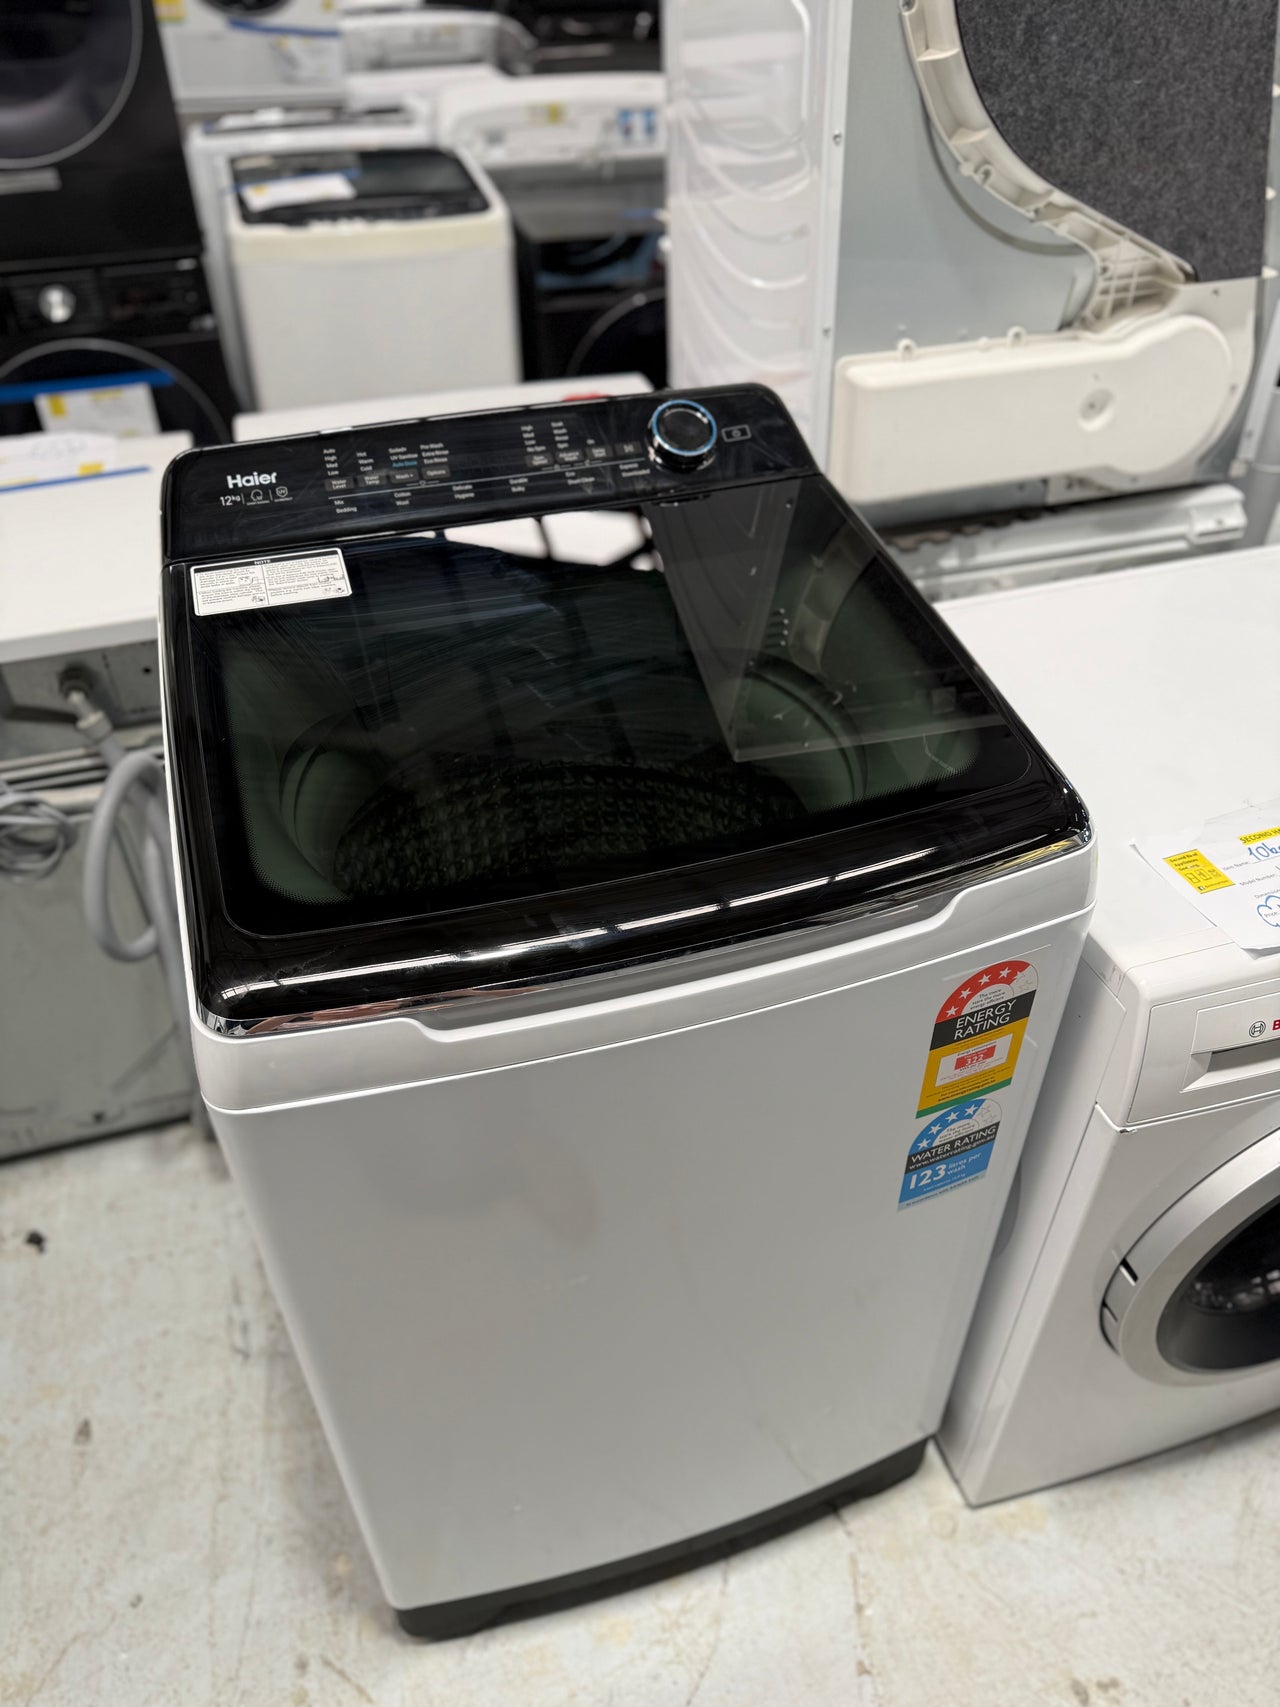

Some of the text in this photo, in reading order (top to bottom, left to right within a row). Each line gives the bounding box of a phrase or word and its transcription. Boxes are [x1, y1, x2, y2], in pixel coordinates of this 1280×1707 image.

[226, 471, 277, 489] Haier
[220, 495, 241, 506] 12kg
[1239, 832, 1273, 844] SECOND
[956, 999, 1017, 1029] ENERGY
[954, 1012, 1011, 1040] RATING
[911, 1125, 997, 1163] WATER RATING
[909, 1164, 947, 1190] 123
[947, 1164, 966, 1175] wash
